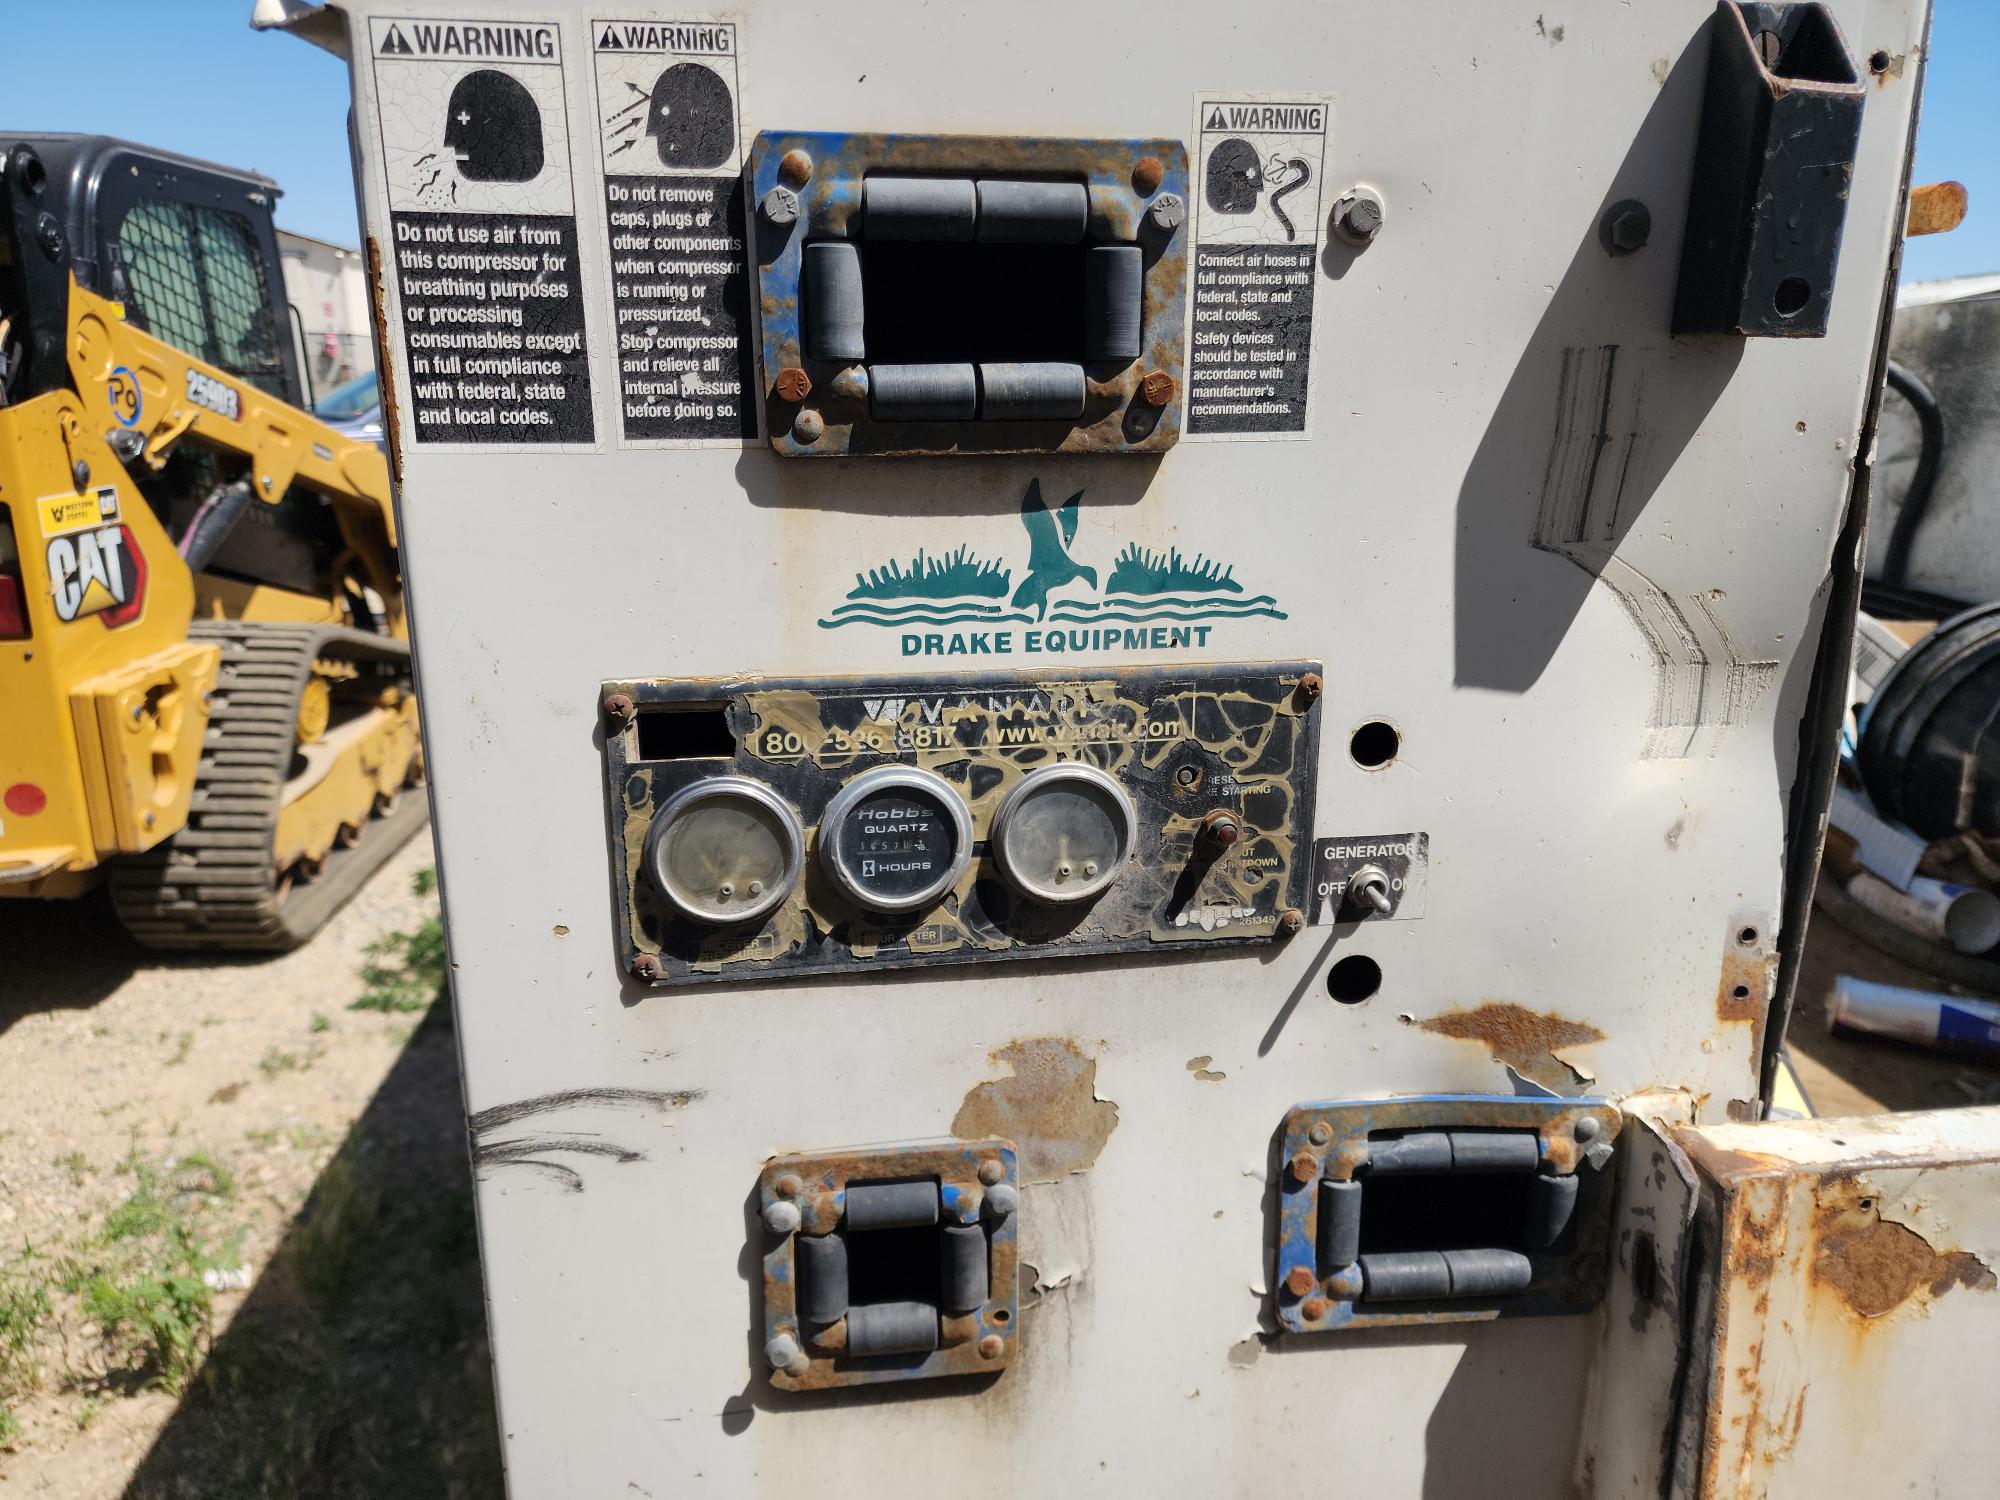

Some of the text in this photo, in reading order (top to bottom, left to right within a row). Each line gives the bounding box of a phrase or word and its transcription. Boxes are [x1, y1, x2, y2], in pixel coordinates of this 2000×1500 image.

[413, 25, 554, 59] WARNING
[624, 26, 730, 53] WARNING
[1230, 107, 1321, 130] WARNING
[609, 185, 714, 202] Do not remove
[611, 212, 712, 229] caps, plugs or
[397, 223, 561, 245] Do not use air from
[613, 235, 741, 253] other components
[400, 251, 566, 273] this compressor for
[615, 261, 741, 277] when compressor
[1199, 254, 1310, 268] Connect air hoses in
[1198, 272, 1308, 288] full compliance with
[404, 278, 568, 300] breathing purposes
[617, 284, 706, 300] is running or
[1197, 290, 1291, 305] federal, state and
[408, 306, 522, 326] or processing
[1196, 309, 1260, 321] local codes.
[411, 331, 581, 353] consumables except
[621, 334, 739, 352] Stop compressor
[1195, 332, 1274, 347] Safety devices
[1194, 349, 1296, 363] should be tested in
[414, 356, 562, 377] in full compliance
[624, 357, 719, 372] and relieve all
[1194, 367, 1283, 380] accordance with
[416, 381, 566, 402] with federal, state
[625, 381, 741, 398] internal pressure
[1192, 385, 1274, 399] manufacturer's
[419, 408, 553, 424] and local codes.
[627, 403, 736, 420] before doing so.
[1192, 401, 1291, 415] recommendations.
[47, 526, 126, 621] CAT
[901, 625, 1213, 657] DRAKE EQUIPMENT
[1222, 785, 1271, 796] STARTING
[858, 807, 935, 820] Hobbs
[864, 823, 929, 834] QUARTZ
[1324, 843, 1416, 860] GENERATOR
[879, 862, 932, 872] HOURS
[1317, 881, 1347, 896] OFF
[1239, 915, 1275, 926] 261349
